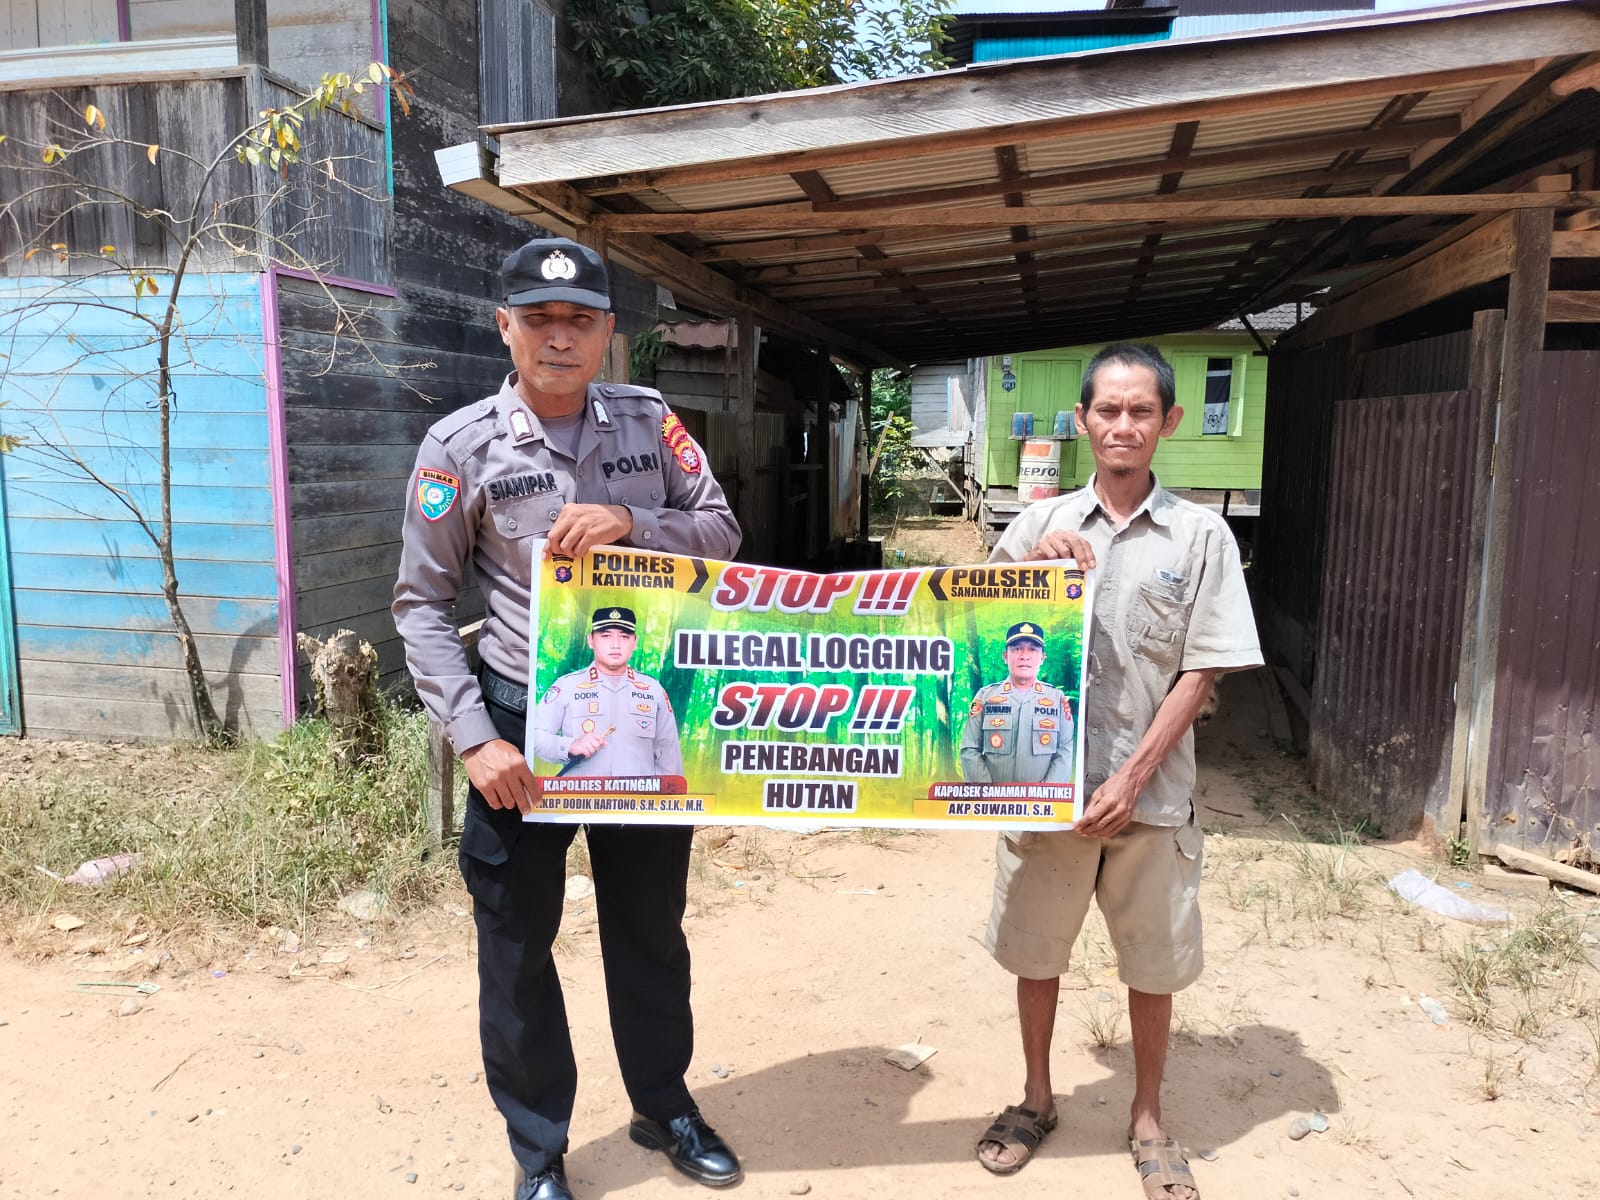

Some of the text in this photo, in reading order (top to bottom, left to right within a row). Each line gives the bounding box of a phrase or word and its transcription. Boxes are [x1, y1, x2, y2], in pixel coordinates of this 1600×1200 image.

[602, 452, 659, 478] POLRI
[489, 472, 557, 501] SIANIPAR
[593, 553, 675, 574] POLRES
[592, 573, 674, 589] KATINGAN
[951, 569, 1050, 588] POLSEK
[715, 566, 921, 611] STOP !!!
[951, 586, 1050, 600] SANAMAN MANTIKEI
[678, 633, 951, 671] ILLEGAL LOGGING
[574, 691, 599, 700] DODIK
[714, 685, 913, 730] STOP !!!
[1034, 707, 1058, 716] POLRI
[724, 744, 899, 774] PENEBANGAN
[543, 779, 660, 792] KAPOLRES KATINGAN
[934, 786, 1072, 799] KAPOLSEK SANAMAN MANTIKEI
[536, 798, 561, 809] KBP
[563, 798, 592, 810] DODIK
[594, 799, 638, 811] HARTONO,
[685, 800, 704, 812] M.H.
[766, 783, 854, 809] HUTAN
[948, 804, 1054, 816] AKP SUWARDI, S.H.
